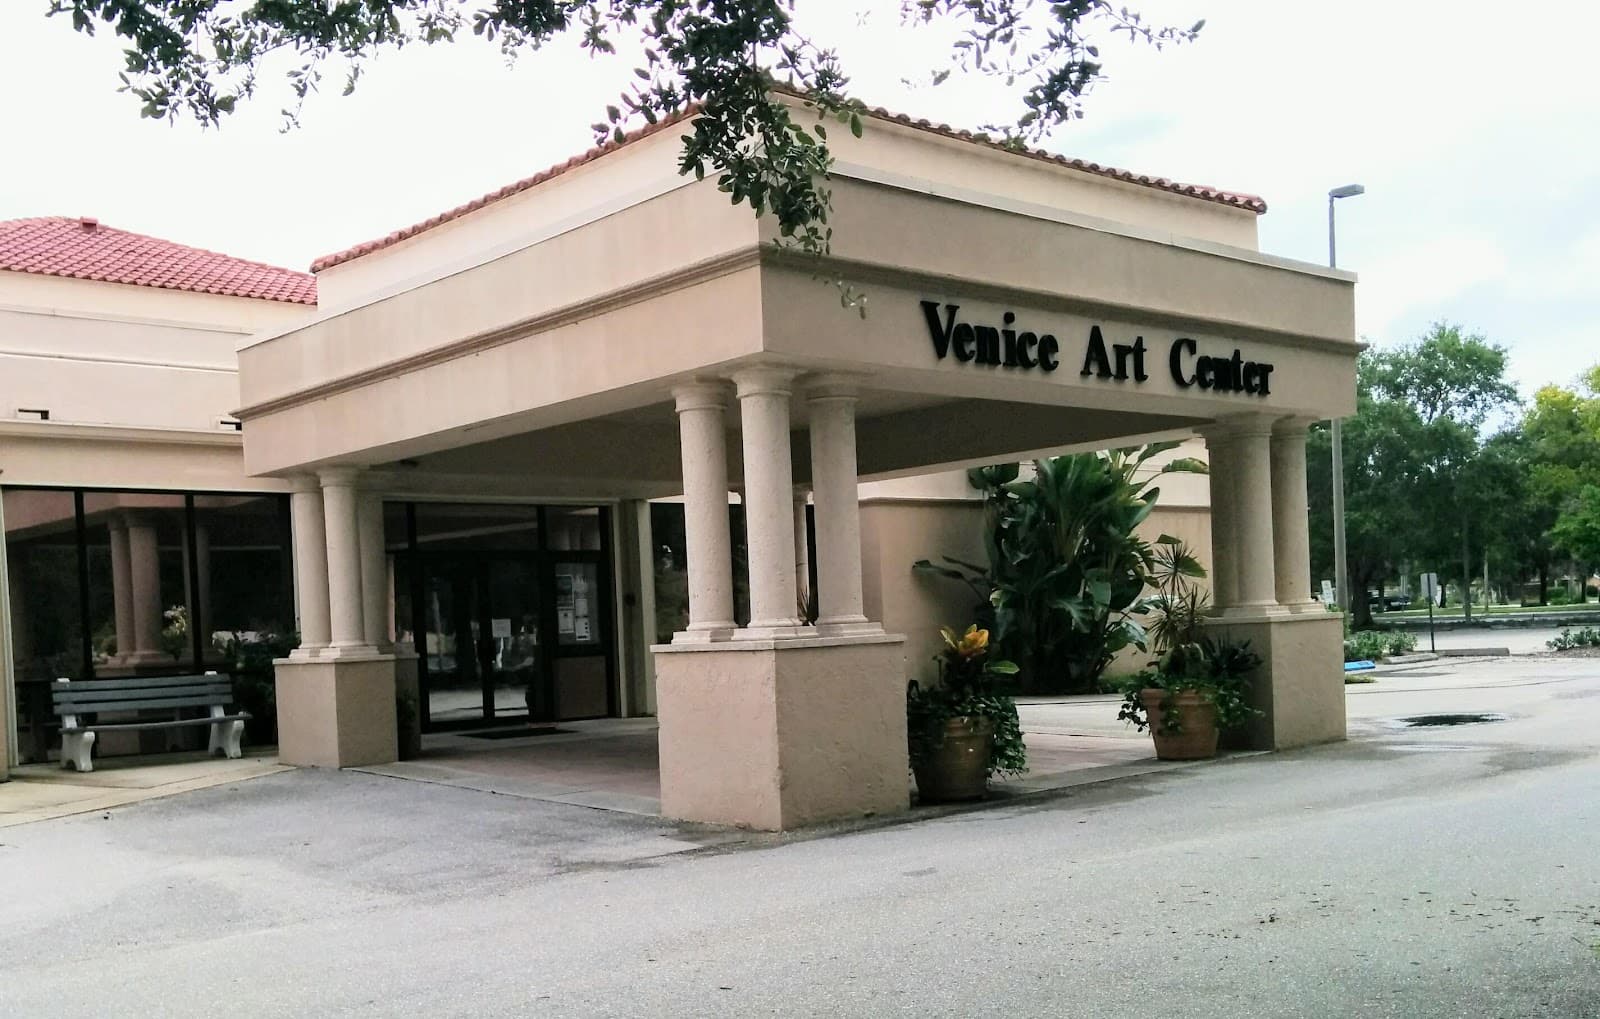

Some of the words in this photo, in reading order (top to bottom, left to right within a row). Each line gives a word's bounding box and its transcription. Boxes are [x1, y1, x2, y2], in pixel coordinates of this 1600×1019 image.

[920, 301, 1060, 373] Venice
[1080, 325, 1149, 383] Art
[1169, 337, 1274, 397] Center
